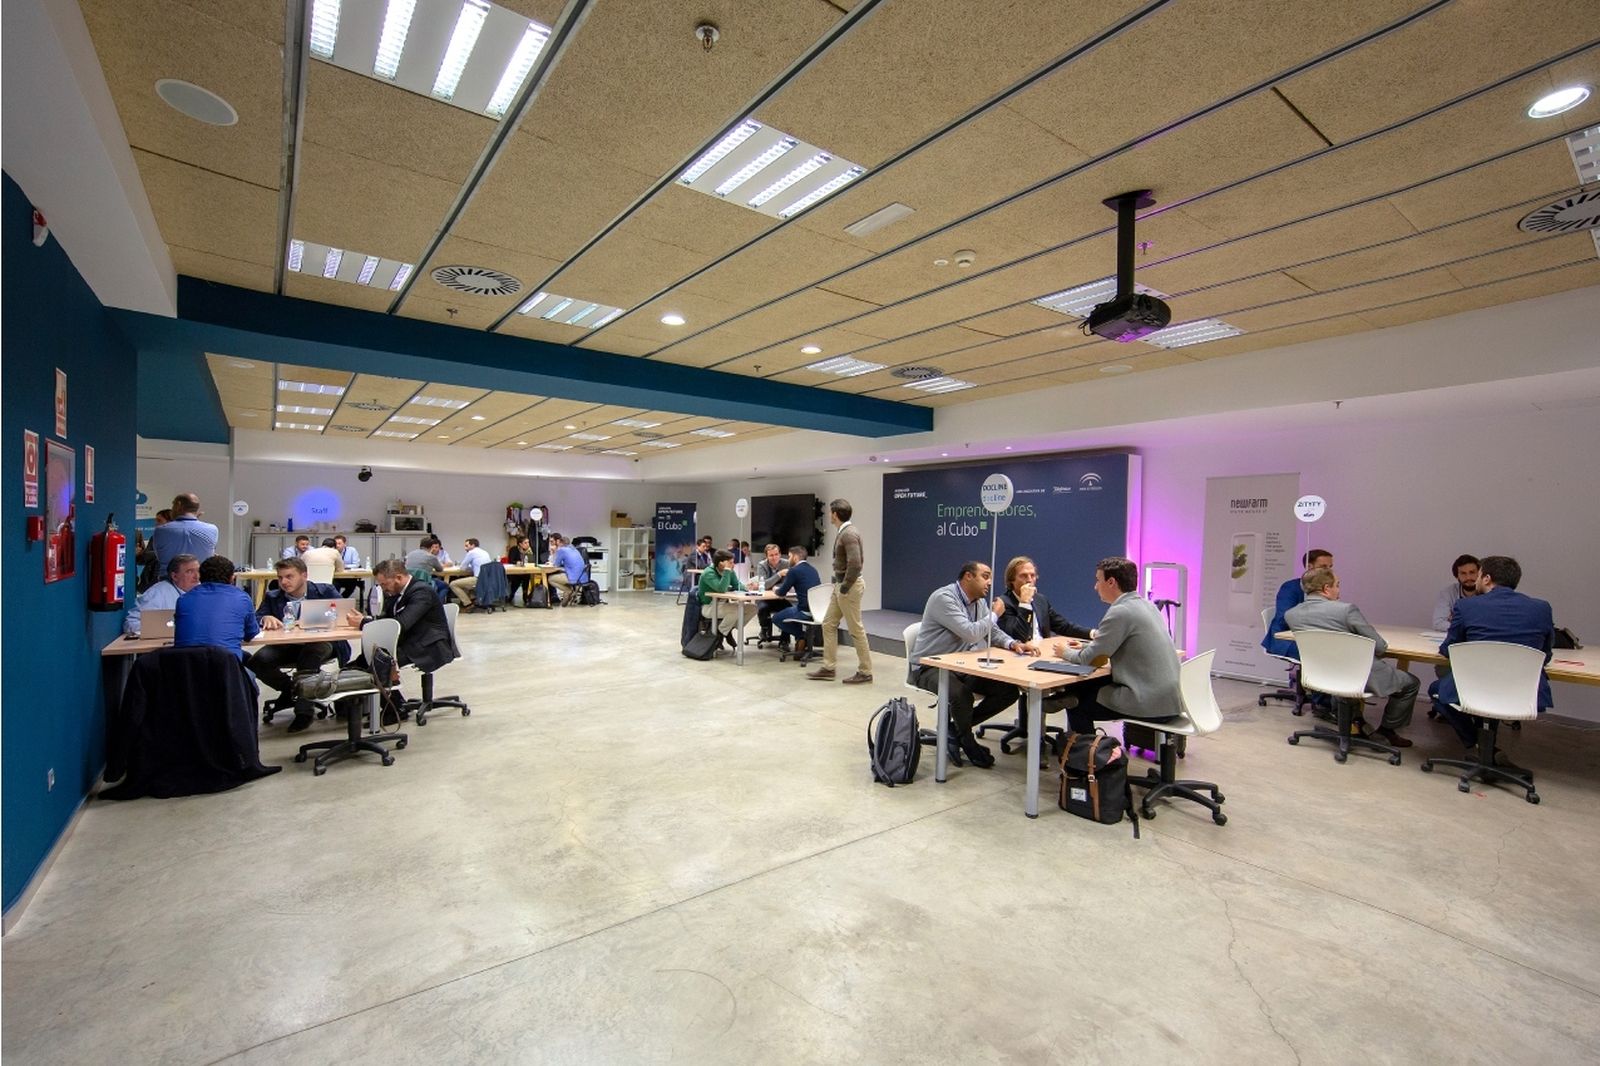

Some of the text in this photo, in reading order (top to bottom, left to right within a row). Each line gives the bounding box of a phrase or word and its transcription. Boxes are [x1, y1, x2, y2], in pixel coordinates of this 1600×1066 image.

[665, 521, 683, 530] Cubo
[936, 521, 979, 537] al Cubo
